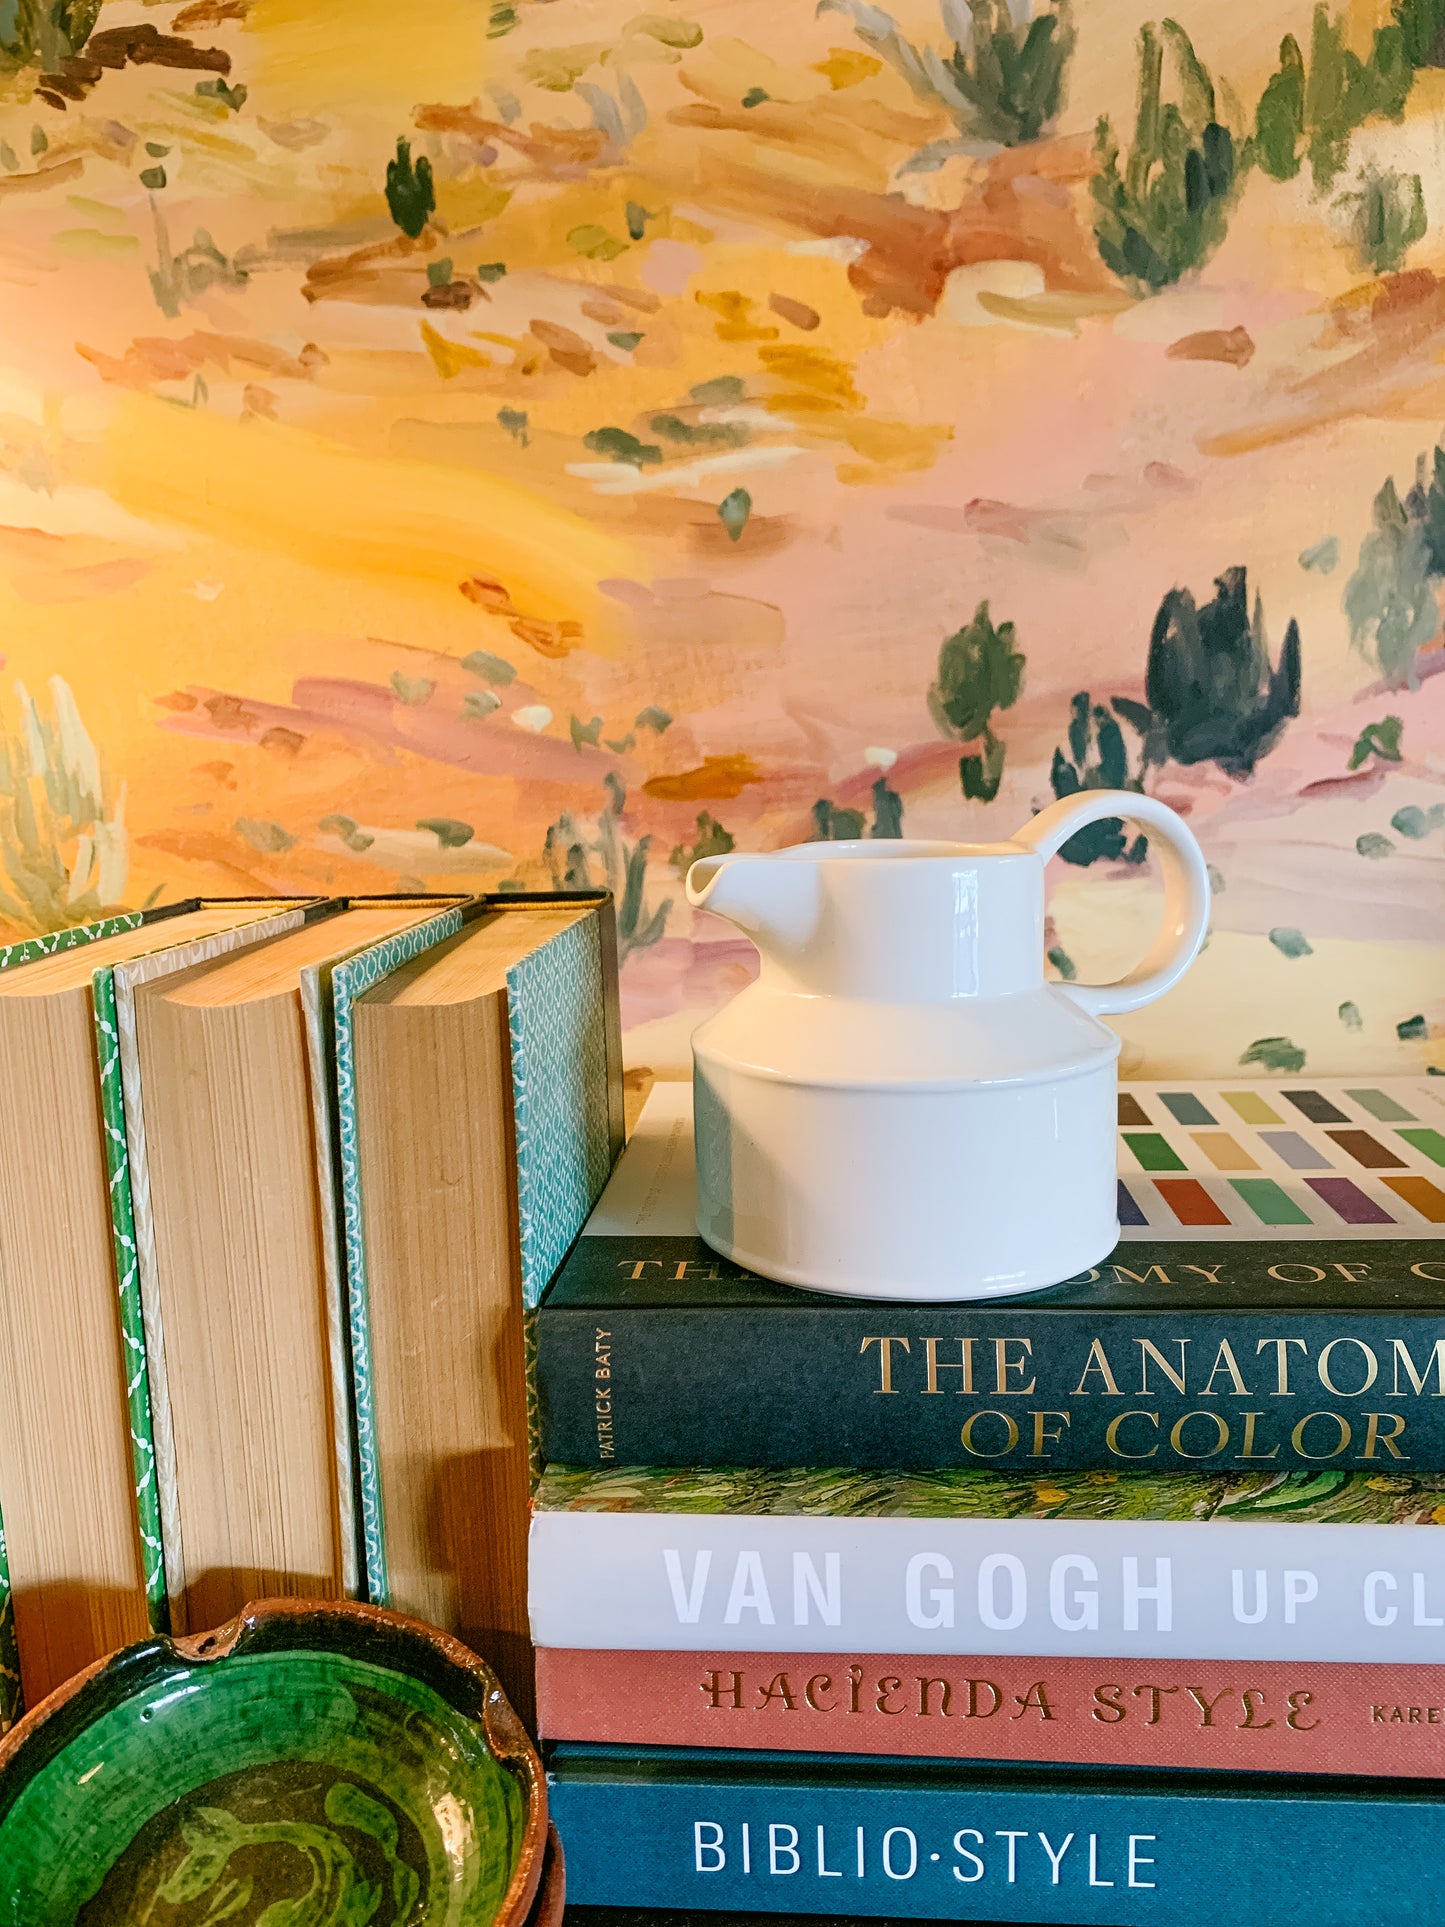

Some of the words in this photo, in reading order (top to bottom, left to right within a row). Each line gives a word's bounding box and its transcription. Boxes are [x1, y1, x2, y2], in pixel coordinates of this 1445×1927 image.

[1267, 1263, 1373, 1284] OF
[595, 1327, 612, 1379] BATY
[859, 1335, 1037, 1395] THE
[1070, 1337, 1445, 1397] ANATOM
[595, 1387, 615, 1459] PATRICK
[960, 1410, 1072, 1458] OF
[1105, 1410, 1411, 1460] COLOR
[662, 1548, 842, 1626] VAN
[905, 1552, 1173, 1632] GOGH
[1231, 1569, 1319, 1624] UP
[1363, 1570, 1445, 1627] CL
[700, 1663, 1057, 1721] HACIENDA
[1092, 1683, 1321, 1731] STYLE
[1370, 1705, 1445, 1724] KARE
